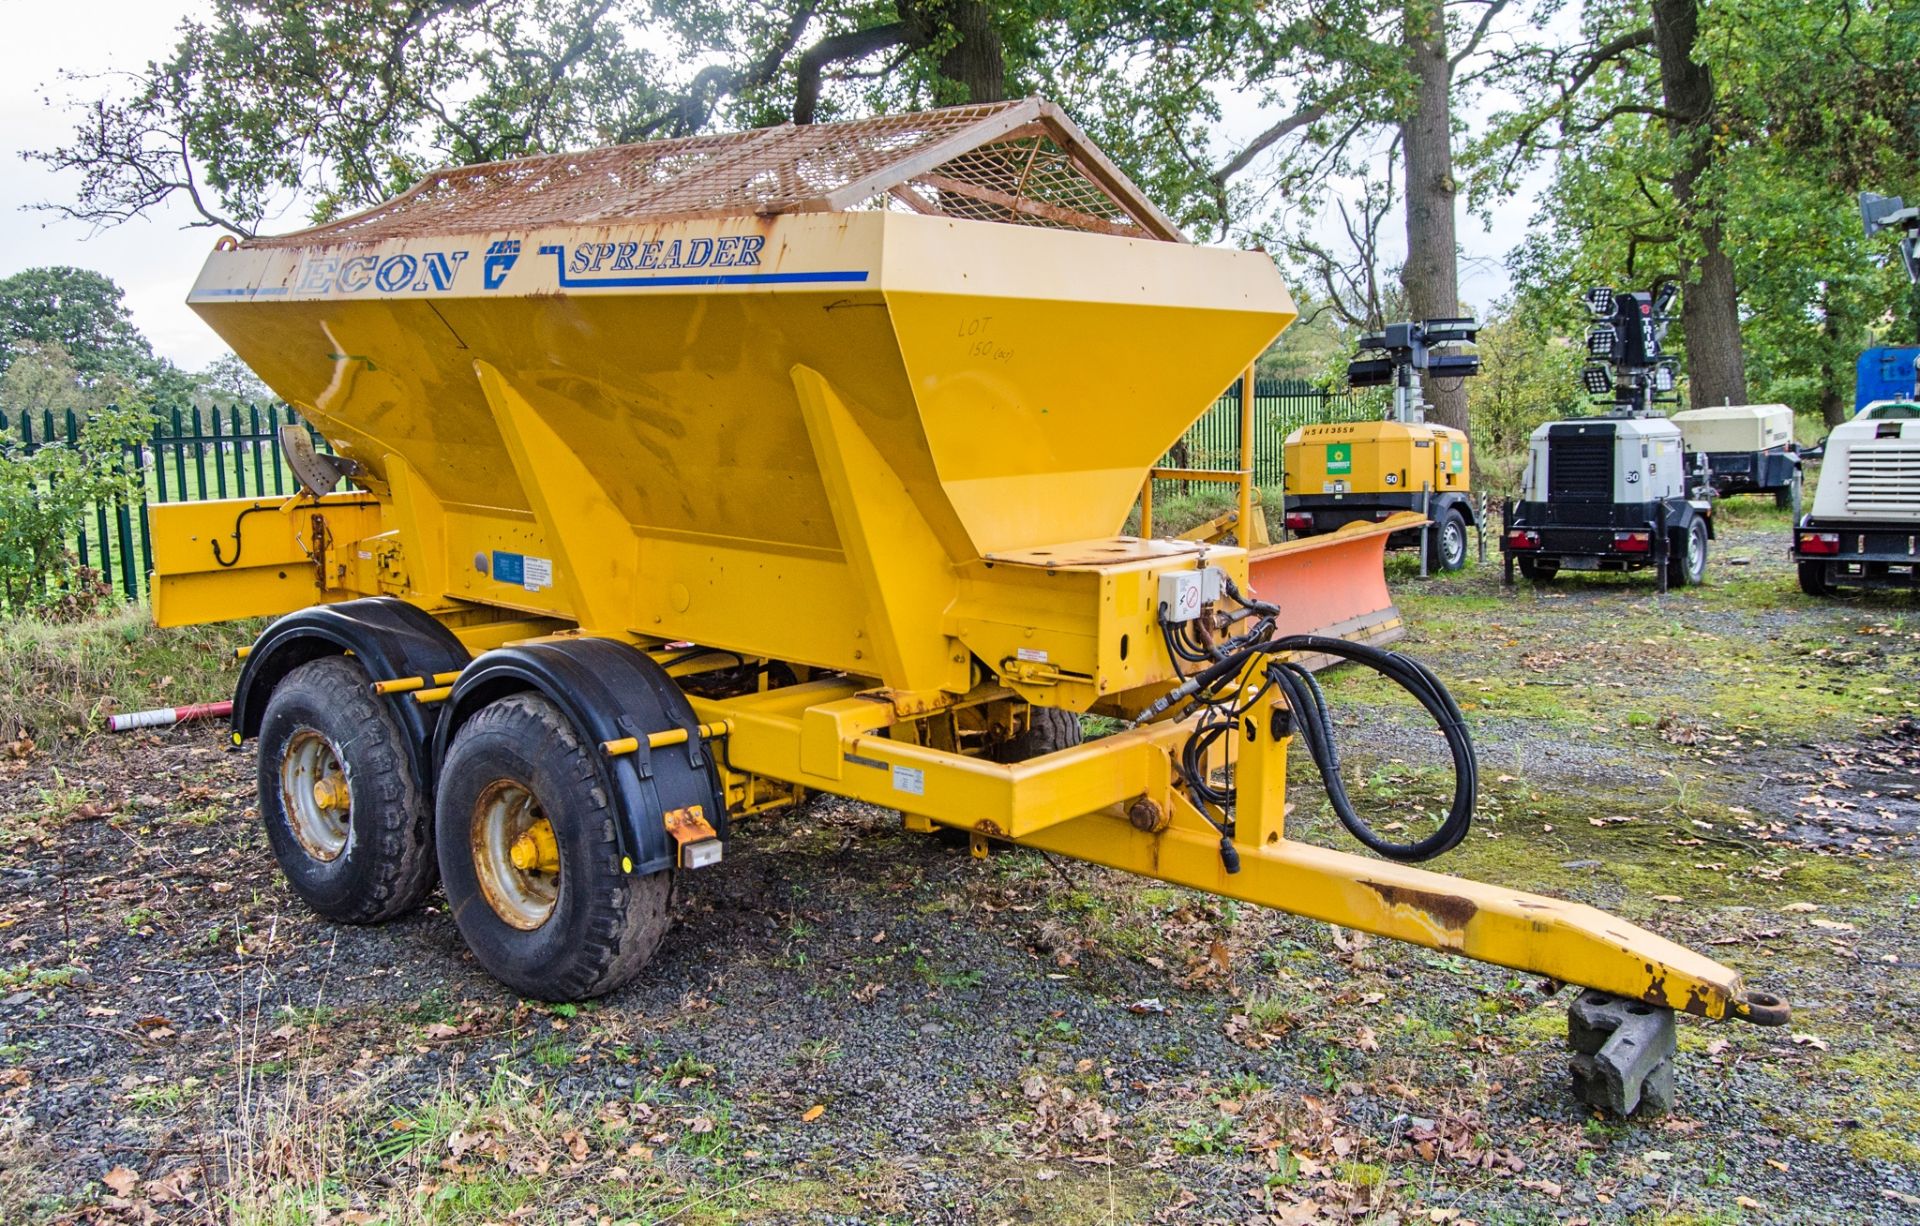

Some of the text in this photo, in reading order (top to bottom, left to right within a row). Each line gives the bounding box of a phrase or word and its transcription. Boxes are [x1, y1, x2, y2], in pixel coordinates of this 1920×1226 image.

[569, 235, 765, 273] SPREADER
[295, 250, 470, 294] ECON
[958, 316, 992, 337] LOT
[1642, 317, 1655, 357] TRIME
[968, 340, 993, 357] 150
[1386, 475, 1398, 483] 50
[1626, 472, 1639, 482] 50
